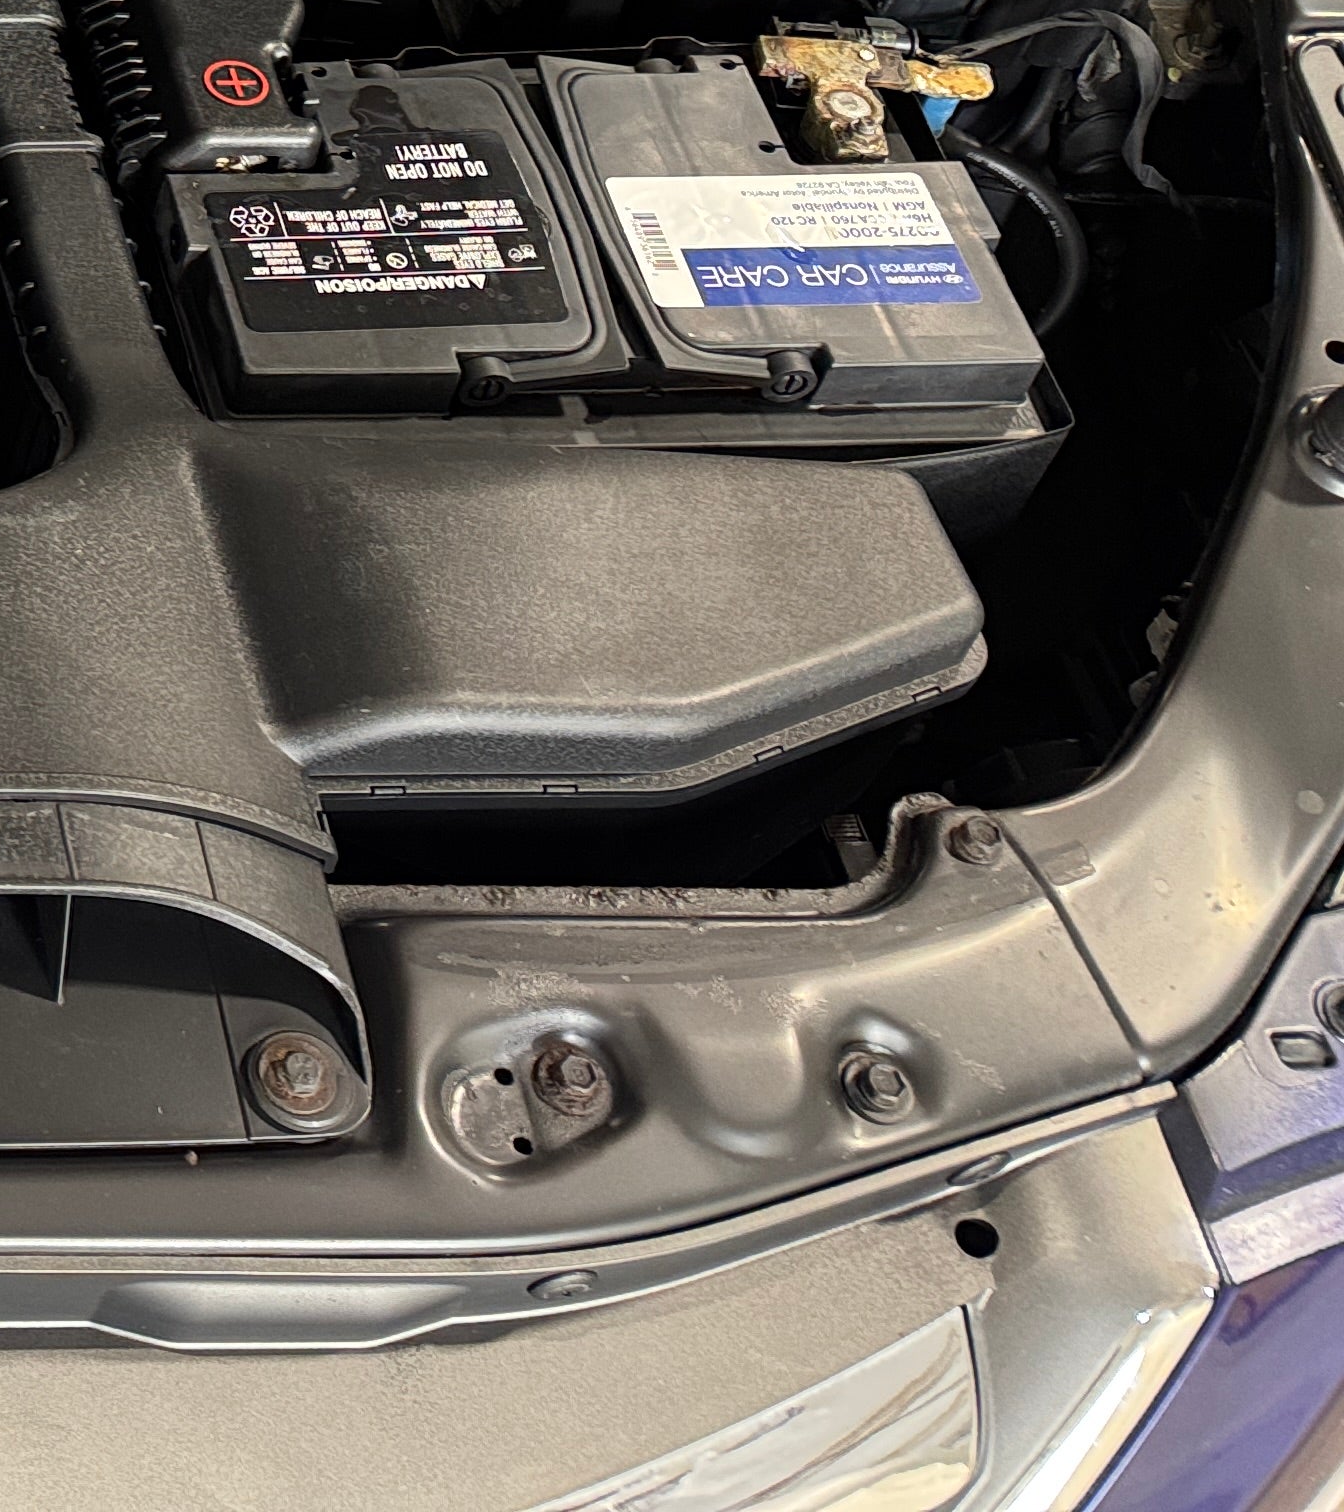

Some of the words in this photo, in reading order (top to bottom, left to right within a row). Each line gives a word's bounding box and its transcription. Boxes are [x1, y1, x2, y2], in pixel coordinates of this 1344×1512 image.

[394, 142, 468, 161] BATTERY!
[384, 163, 427, 180] OPEN
[431, 161, 463, 179] NOT
[463, 161, 488, 177] DO
[792, 201, 879, 213] Nonspillable
[892, 200, 925, 211] AGM
[335, 210, 348, 221] OF
[349, 208, 382, 220] REACH
[304, 222, 325, 232] THE
[325, 222, 339, 232] OF
[340, 221, 360, 232] OUT
[362, 221, 386, 232] KEEP
[879, 262, 956, 273] Assurance
[697, 265, 789, 288] CARE
[796, 264, 868, 287] CAR
[315, 275, 470, 294] DANGER/POISON
